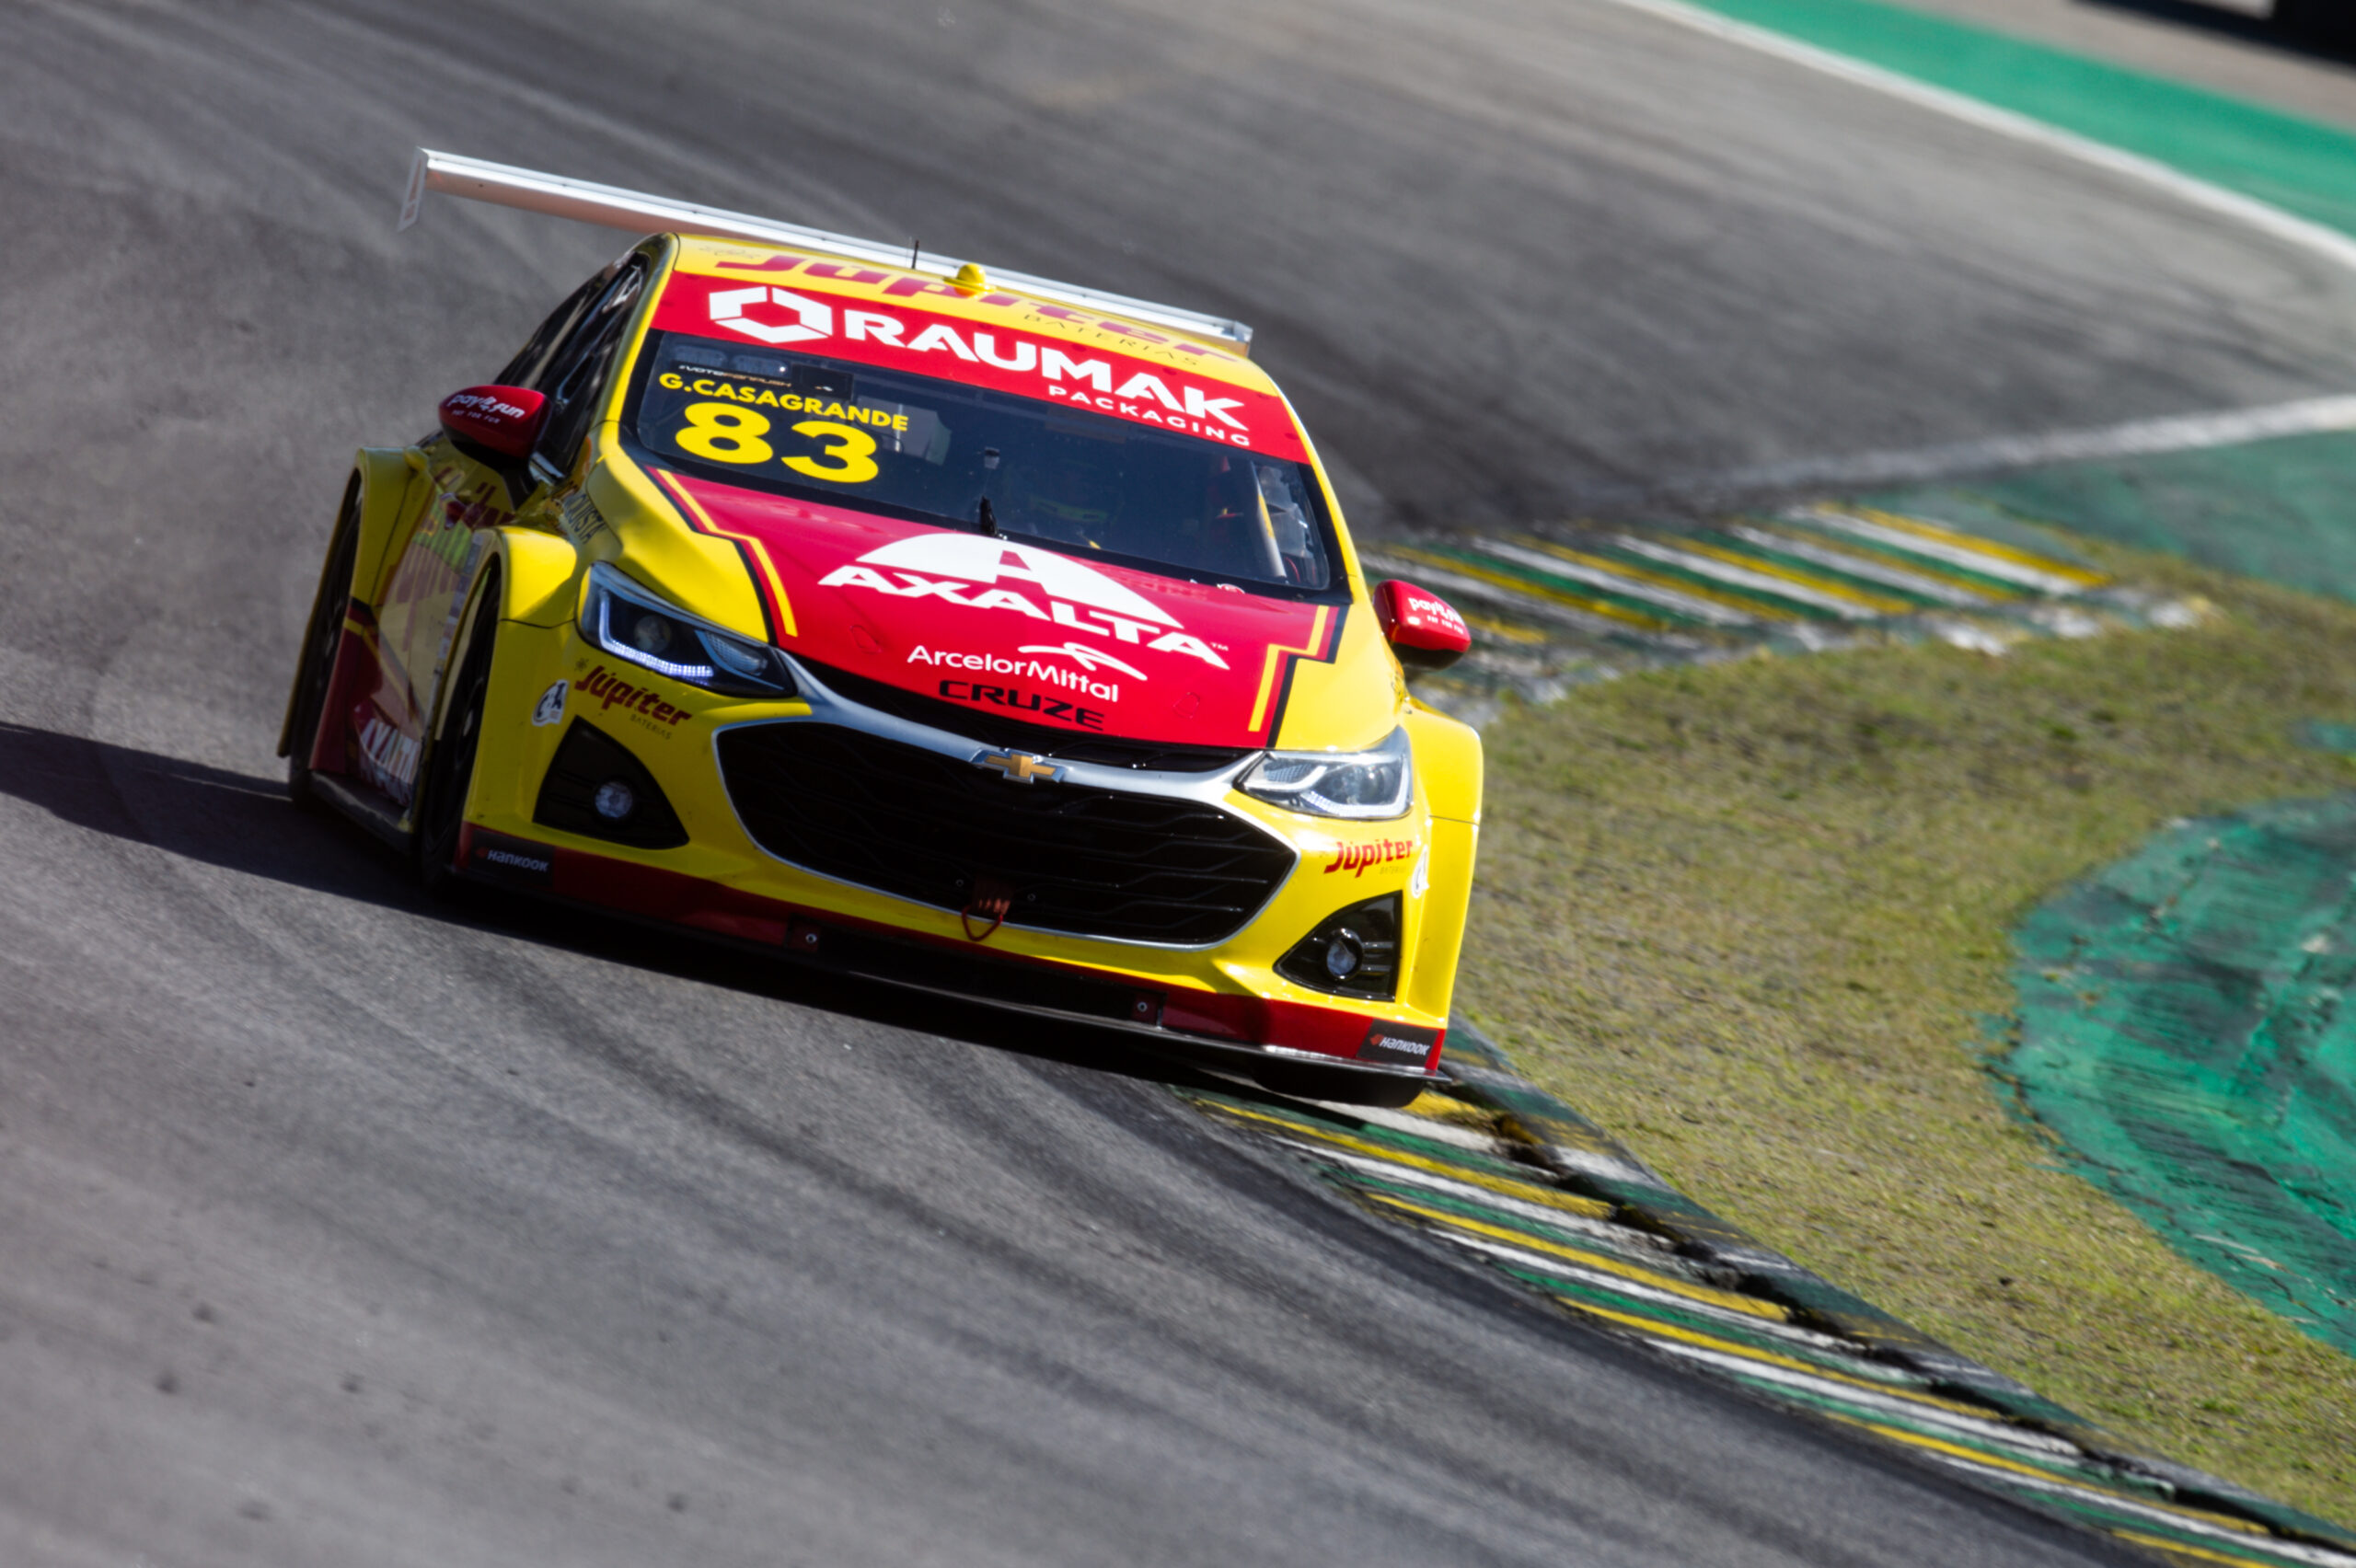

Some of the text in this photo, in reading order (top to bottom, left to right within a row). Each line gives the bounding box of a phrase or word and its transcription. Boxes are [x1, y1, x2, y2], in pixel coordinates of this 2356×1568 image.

[1023, 313, 1199, 366] BATERIAS
[844, 309, 1250, 432] RAUMAK
[659, 373, 909, 432] G.CASAGRANDE
[1049, 385, 1251, 446] PACKAGING
[676, 401, 880, 483] 83
[817, 564, 1230, 670] AXALTA
[907, 645, 1119, 703] ArcelorMittal
[938, 680, 1104, 732] CRUZE
